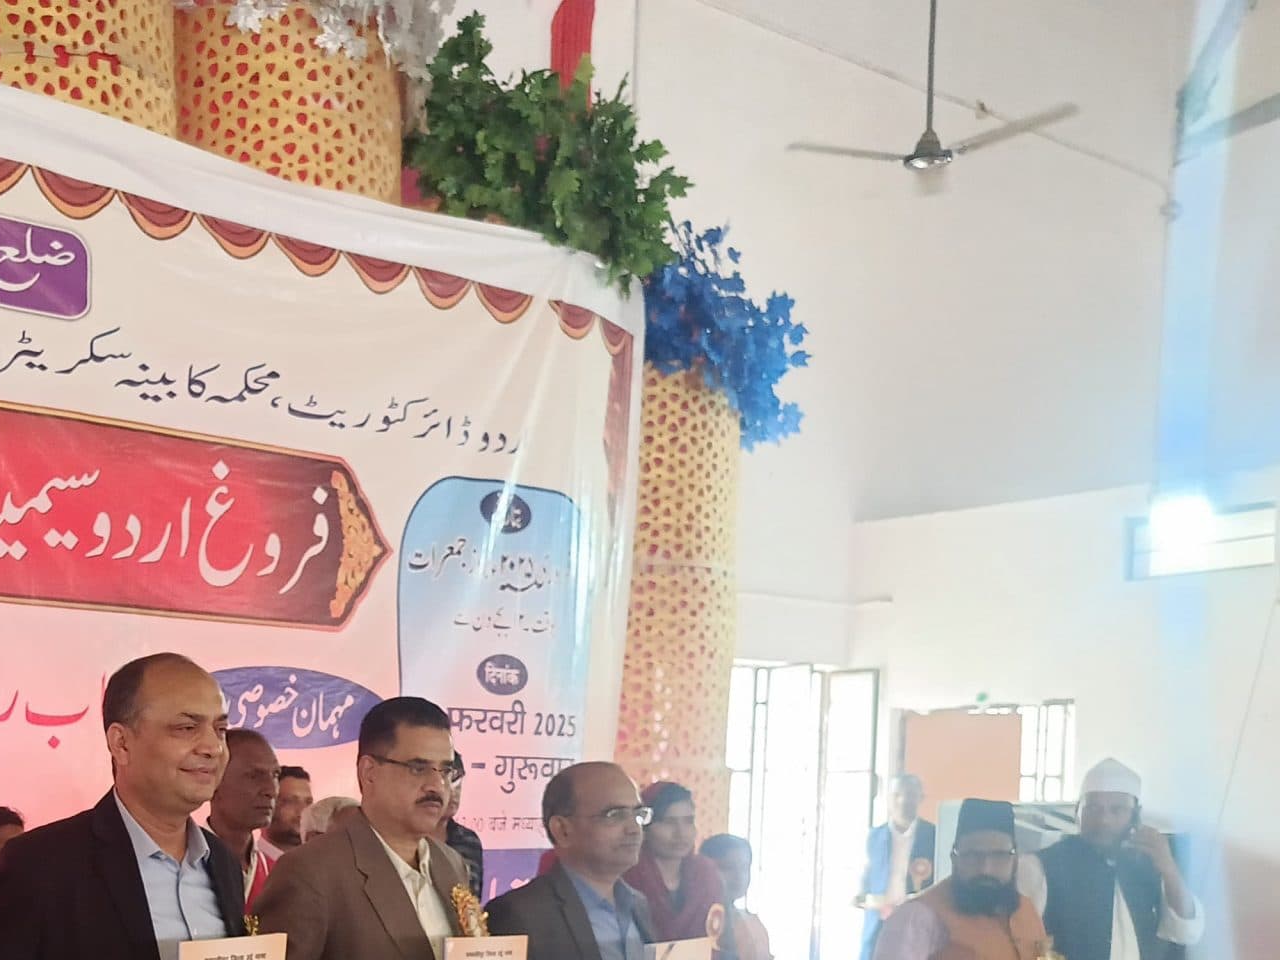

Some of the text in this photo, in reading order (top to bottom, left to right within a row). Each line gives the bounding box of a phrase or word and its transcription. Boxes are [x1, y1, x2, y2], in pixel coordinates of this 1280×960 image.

[85, 496, 193, 563] اردو
[198, 460, 330, 595] فروغ
[484, 661, 521, 687] दिनांक
[292, 690, 355, 740] مہمان
[447, 699, 577, 737] फरवरी 2025
[494, 755, 576, 794] गुरूवा
